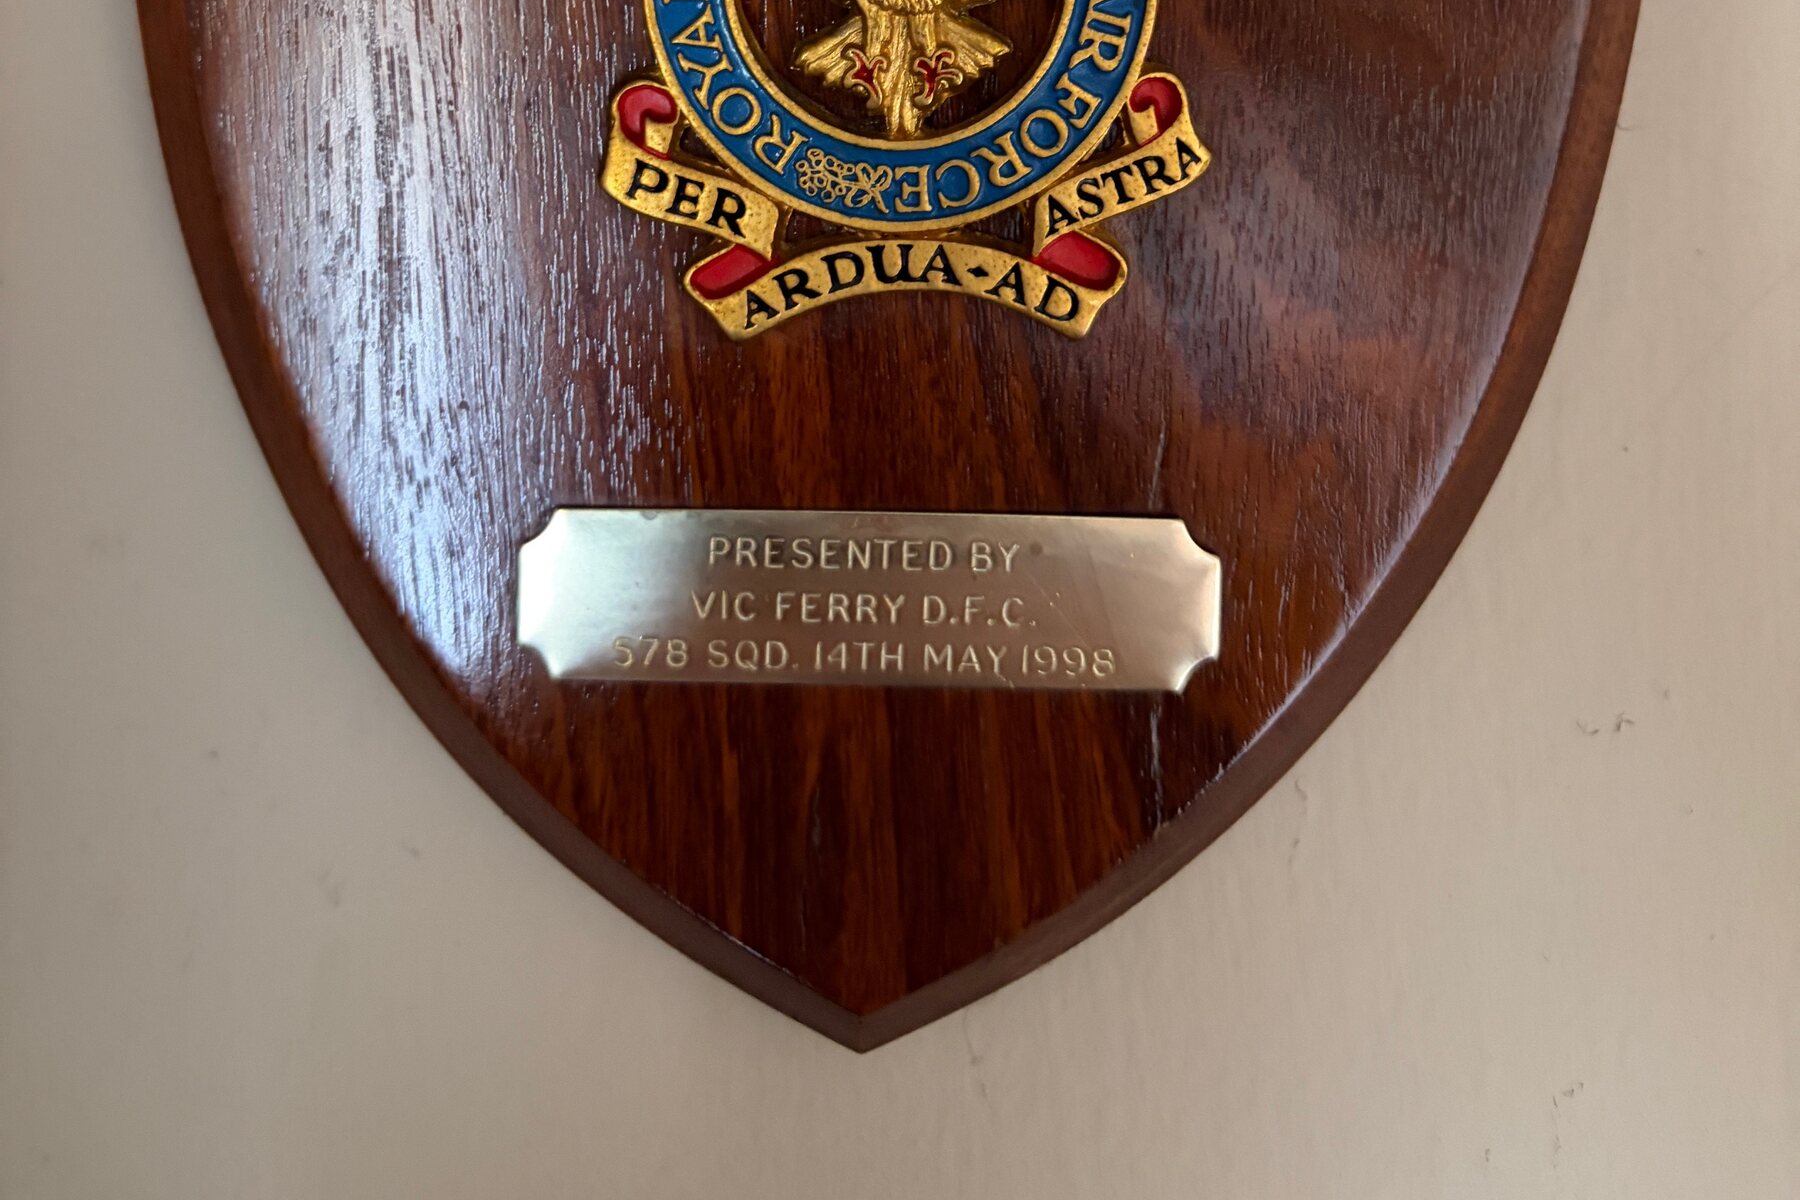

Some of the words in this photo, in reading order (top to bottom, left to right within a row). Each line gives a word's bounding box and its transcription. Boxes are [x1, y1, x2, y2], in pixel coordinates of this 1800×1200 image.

[895, 80, 1105, 213] FORCE
[624, 158, 749, 239] PER
[1045, 138, 1203, 238] ASTRA
[708, 536, 952, 572] PRESENTED
[971, 541, 1021, 573] BY
[690, 589, 757, 622] VIC
[774, 591, 906, 625] FERRY
[923, 596, 1038, 628] D.F.C.
[612, 636, 689, 668] 578
[707, 639, 800, 670] SQD.
[812, 641, 904, 673] 14TH
[923, 643, 1007, 674] MAY
[1020, 645, 1116, 677] 1998
